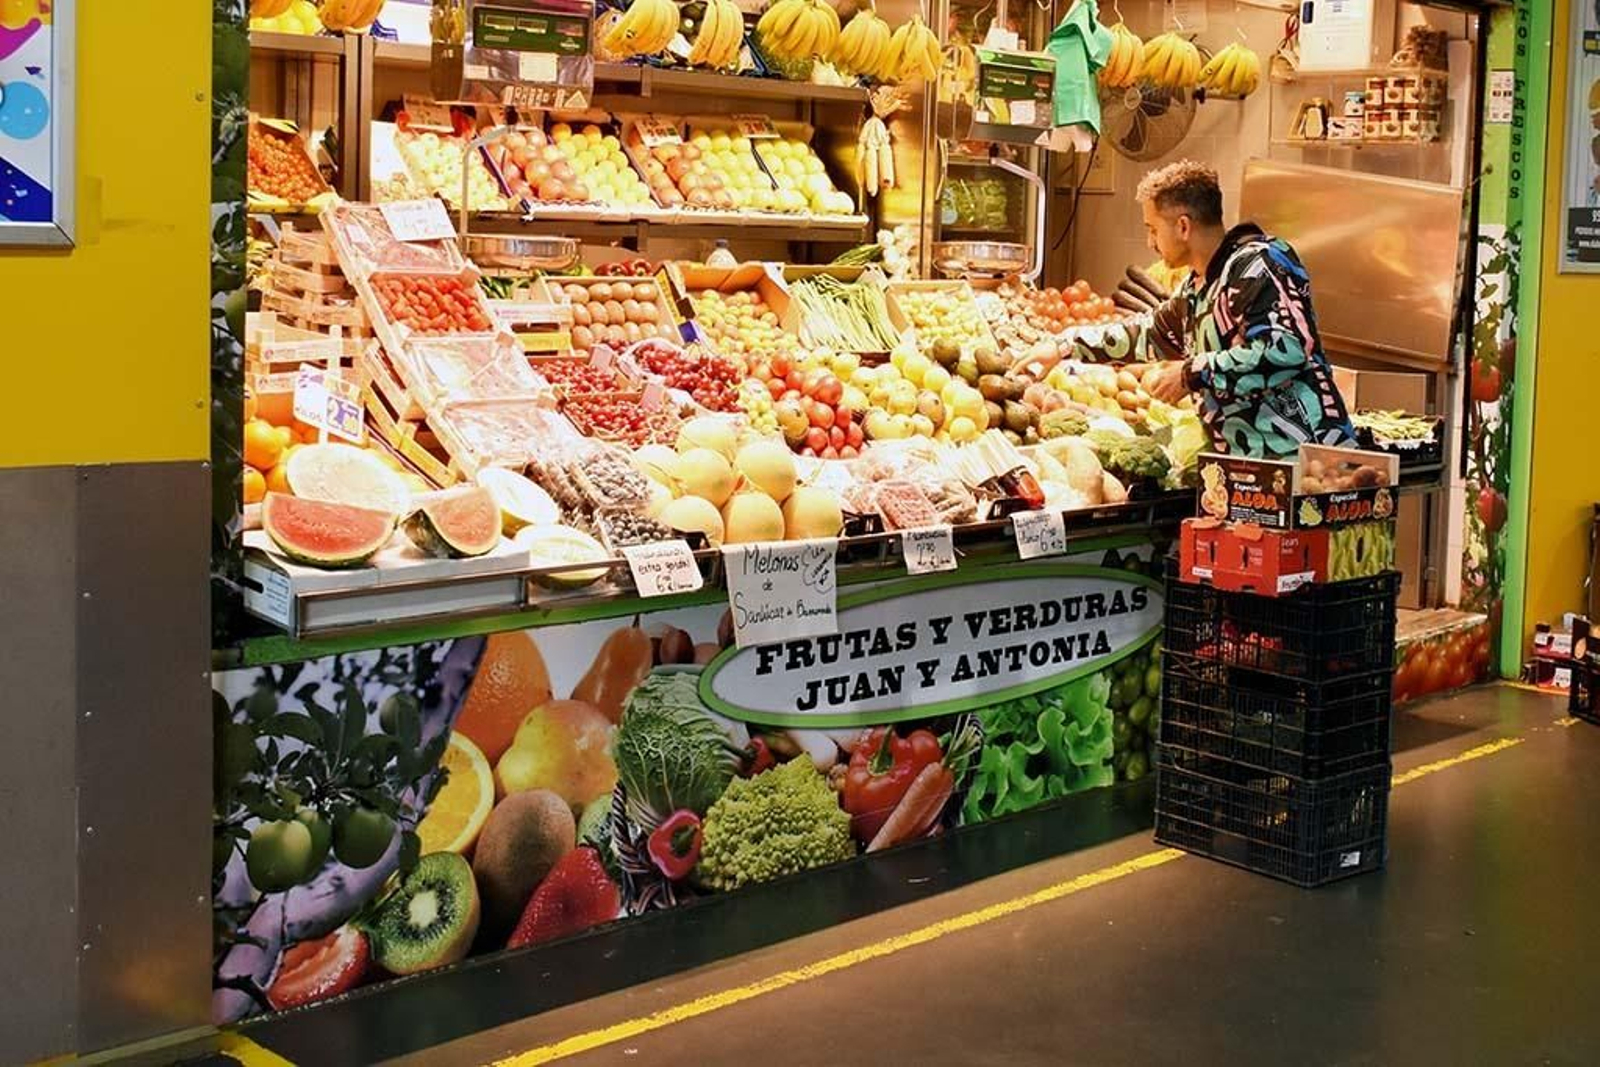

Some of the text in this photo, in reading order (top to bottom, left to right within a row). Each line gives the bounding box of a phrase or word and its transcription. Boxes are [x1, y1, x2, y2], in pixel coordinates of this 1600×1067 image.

[1508, 0, 1529, 199] TOS FRESCOS
[761, 577, 774, 591] de
[756, 587, 1148, 675] FRUTAS Y VERDURAS
[796, 630, 1111, 711] JUAN Y ANTONIA
